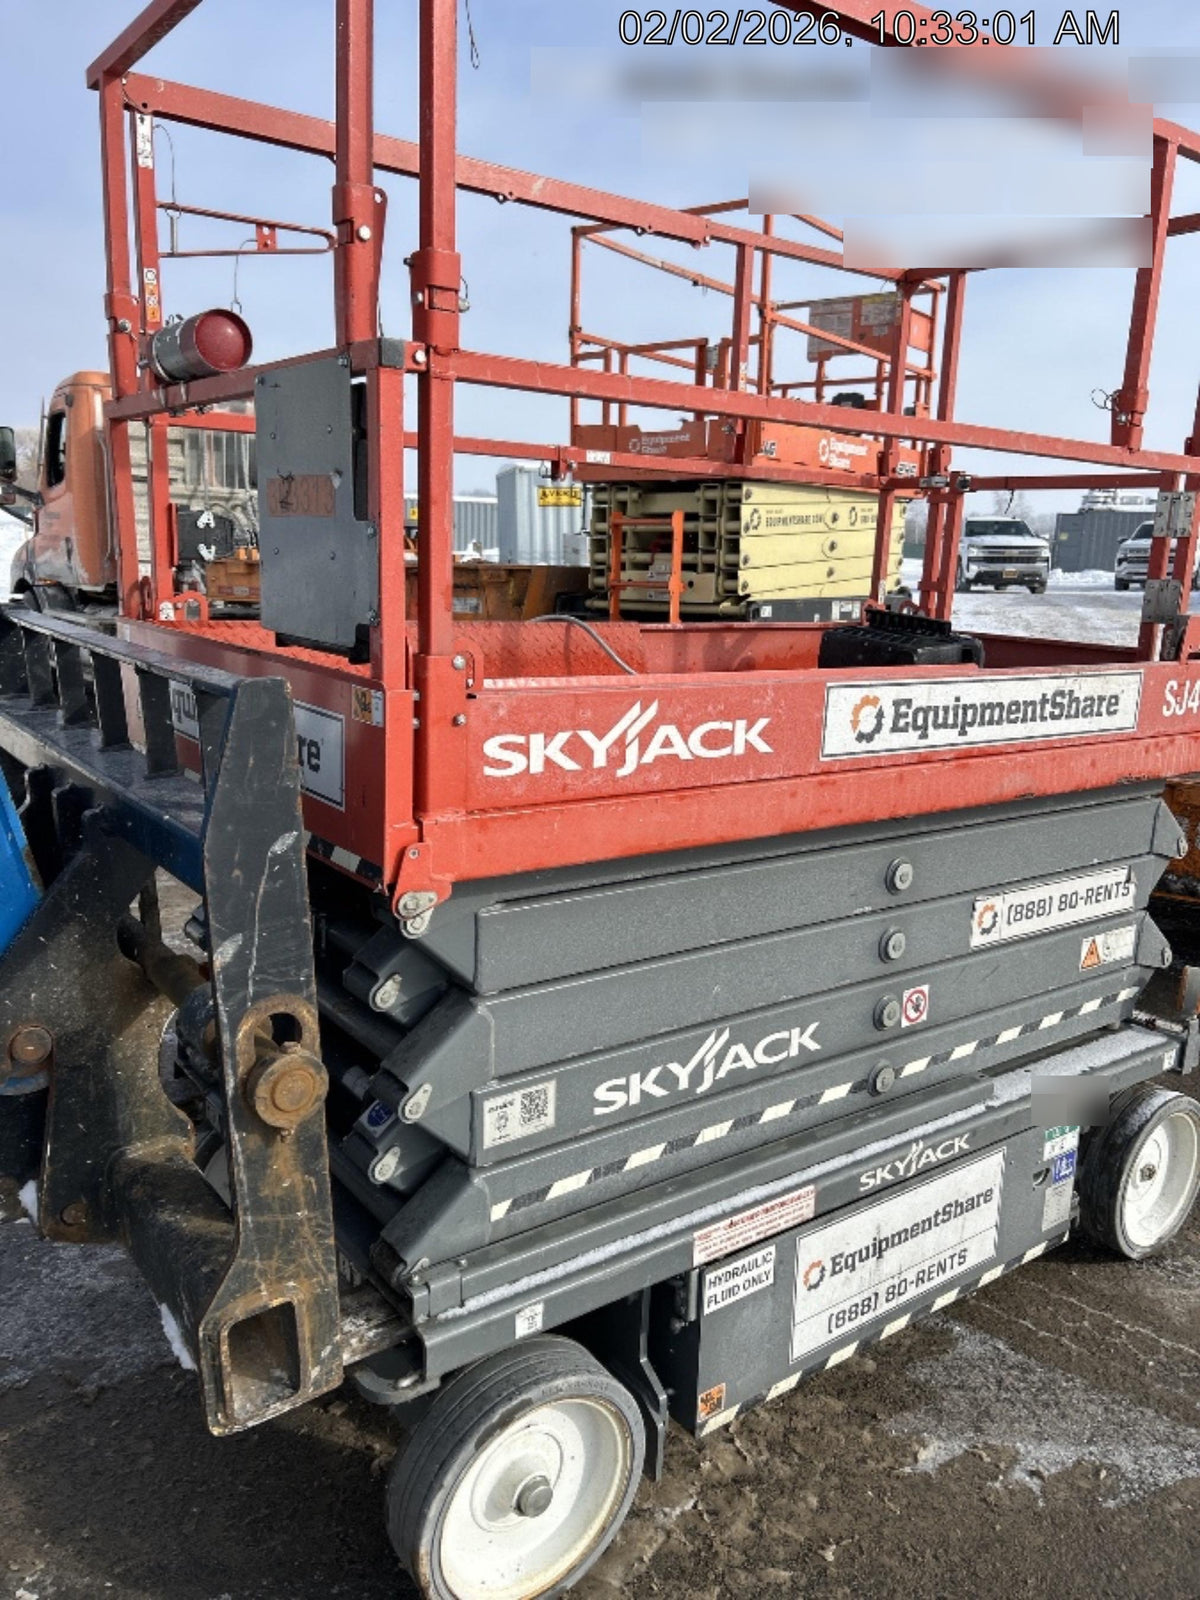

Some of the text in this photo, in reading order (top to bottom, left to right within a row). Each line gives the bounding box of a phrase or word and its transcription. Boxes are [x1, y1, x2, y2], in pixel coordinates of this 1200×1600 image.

[483, 700, 773, 777] SKYJACK
[889, 689, 1120, 739] EquipmentShare
[1006, 881, 1131, 926] (888) 80-RENTS
[593, 1022, 821, 1116] SKYJACK
[859, 1133, 970, 1192] SKYJACK
[829, 1186, 994, 1278] EquipmentShare
[707, 1269, 771, 1309] FLUID ONLY
[708, 1251, 773, 1291] HYDRAULIC
[827, 1248, 969, 1334] (888) 80-RENTS
